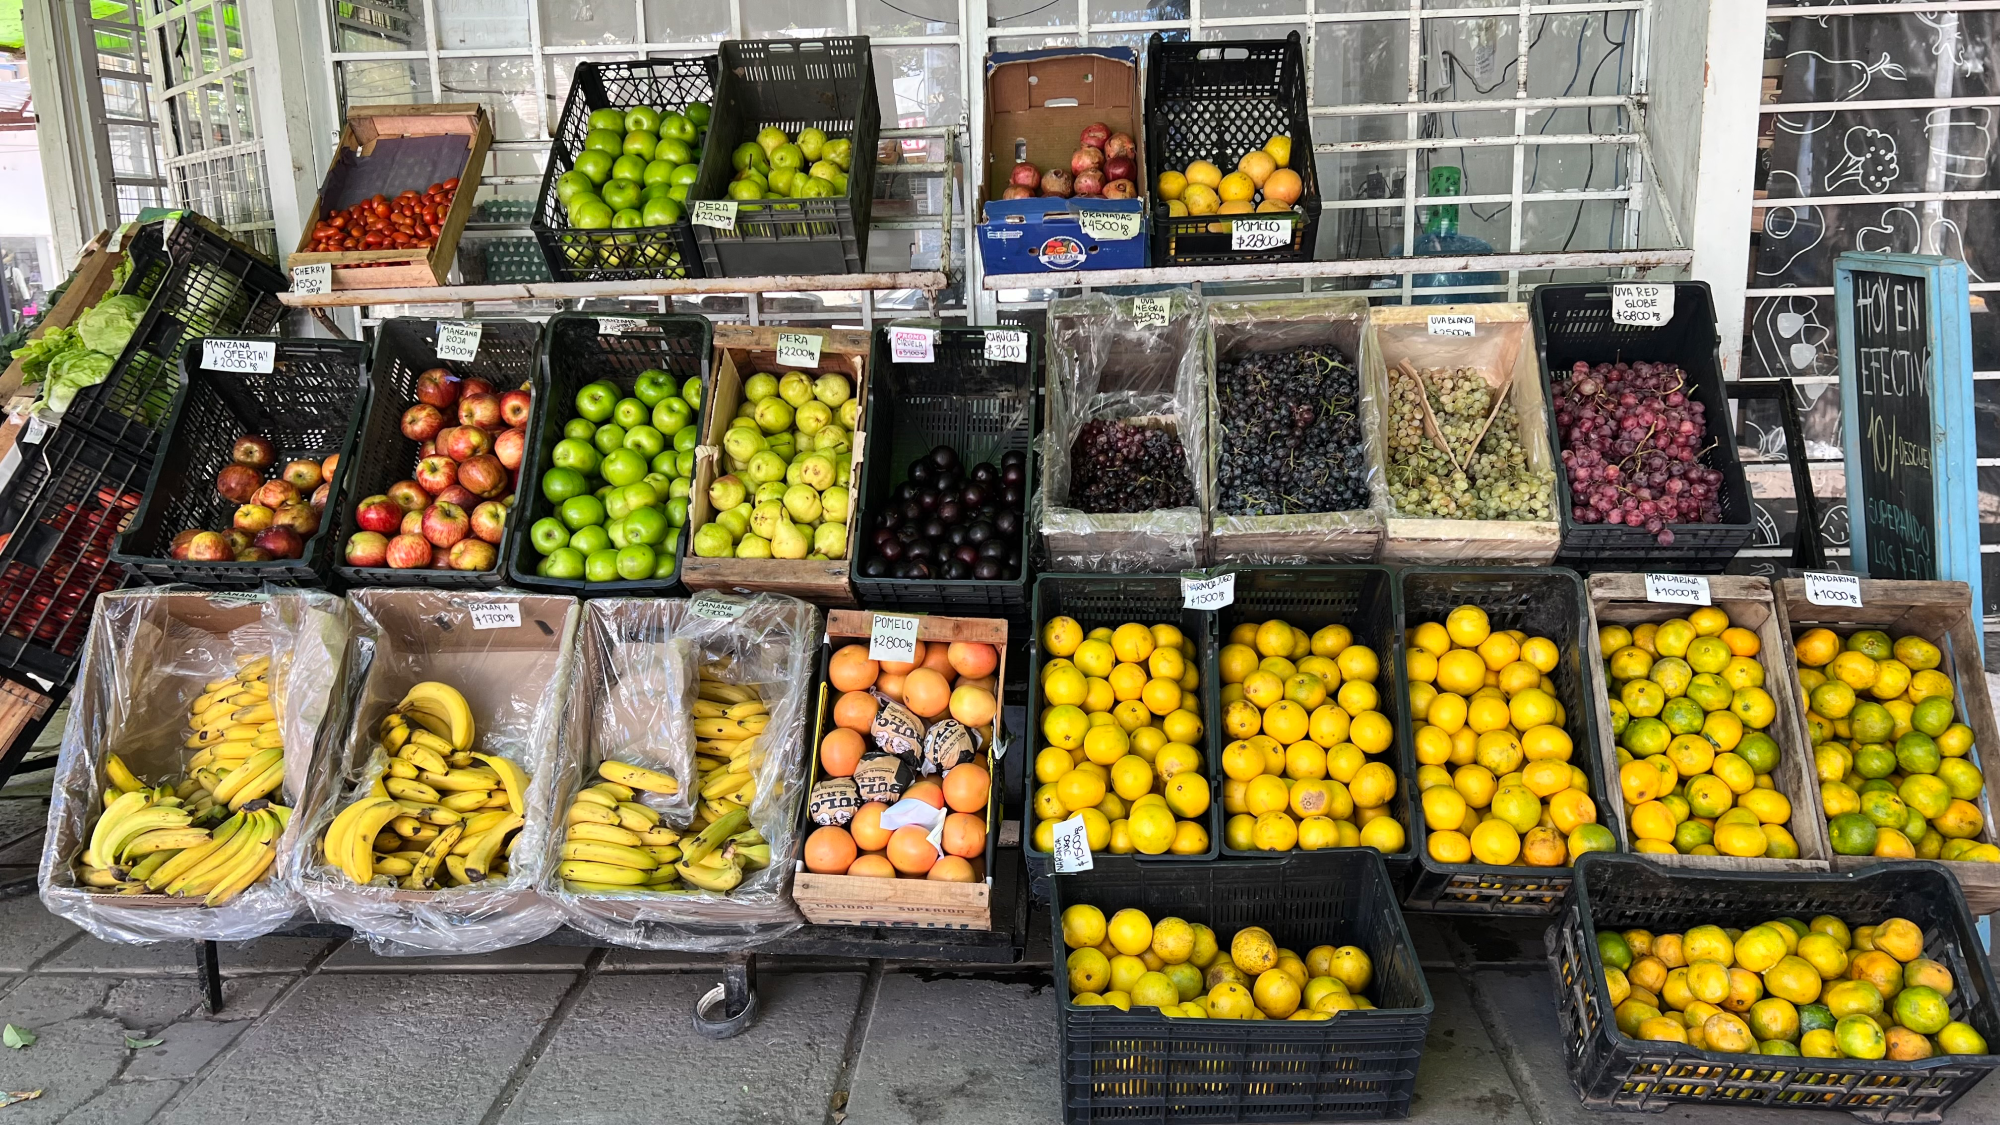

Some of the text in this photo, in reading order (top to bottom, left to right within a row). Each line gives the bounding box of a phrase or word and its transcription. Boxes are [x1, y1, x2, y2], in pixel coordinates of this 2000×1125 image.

[698, 201, 729, 212] PERA
[1234, 220, 1280, 232] POMELO
[294, 265, 325, 276] CHERRY
[1615, 286, 1659, 297] UVA RED
[1136, 304, 1165, 313] NEGRA
[1625, 299, 1658, 308] GLOBE
[1857, 276, 1919, 338] HOY EN
[1431, 316, 1446, 324] UVA
[442, 325, 478, 338] MANZANA
[986, 330, 1020, 342] CIRUELA
[446, 335, 466, 345] ROJA
[780, 334, 808, 345] PERA
[205, 340, 250, 354] MANZANA
[986, 344, 1020, 358] $3100
[1868, 497, 1930, 556] SUPERANDO
[1874, 536, 1896, 571] LOS
[1646, 573, 1700, 585] MANDARINA
[1806, 573, 1857, 586] MANDARINA
[874, 615, 913, 630] POMELO
